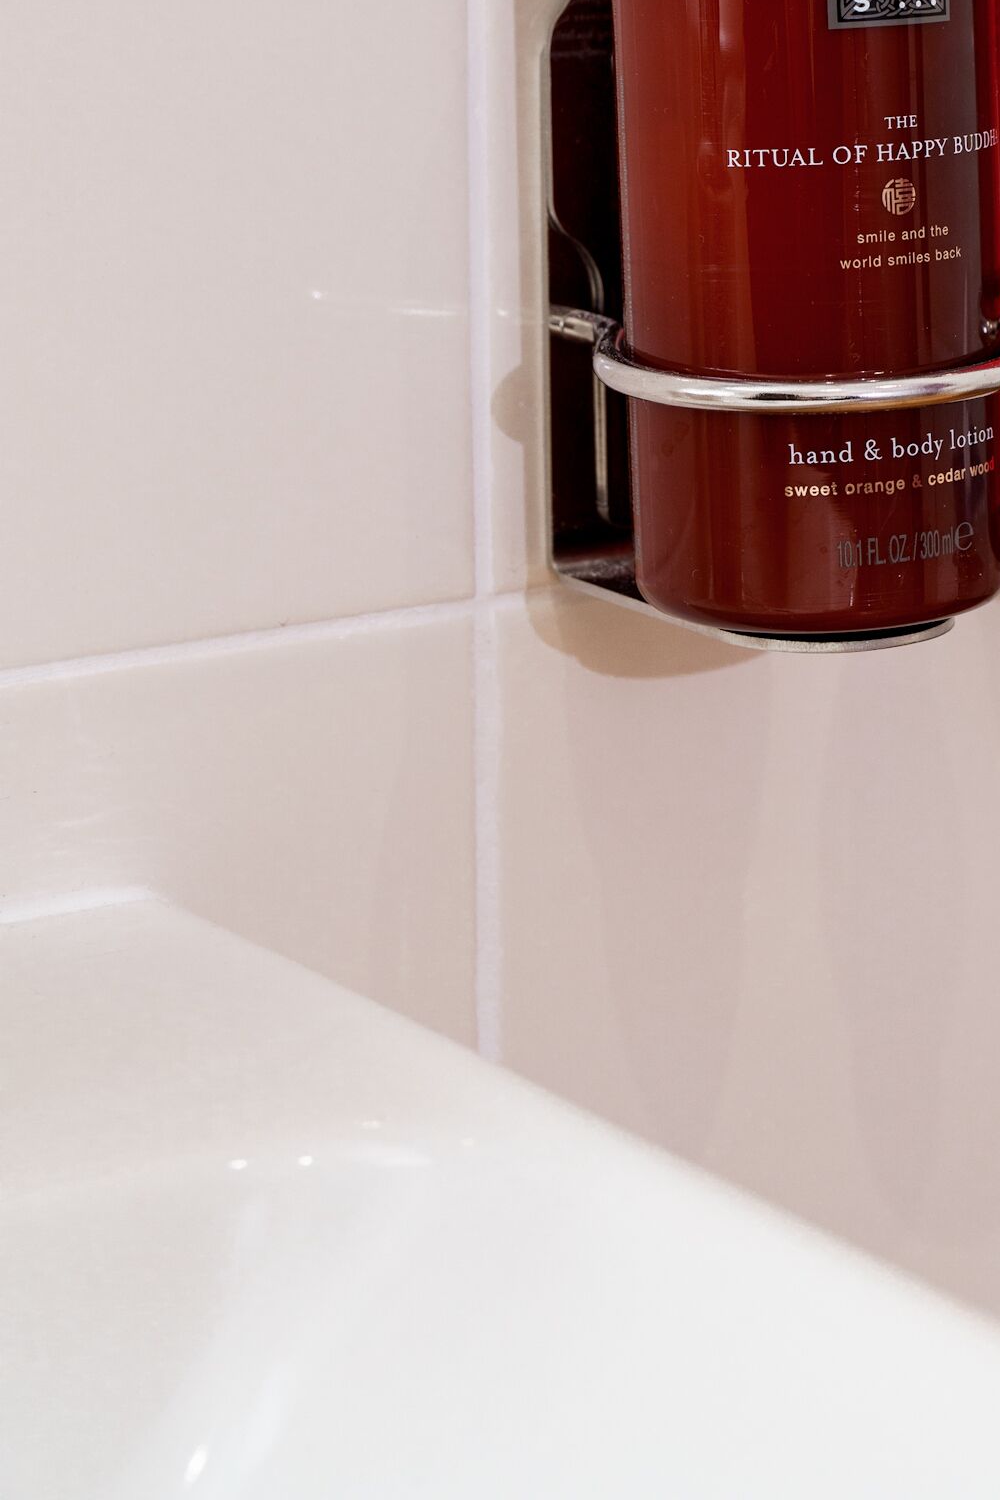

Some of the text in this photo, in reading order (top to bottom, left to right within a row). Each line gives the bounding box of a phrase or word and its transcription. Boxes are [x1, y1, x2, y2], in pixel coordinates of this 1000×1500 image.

[884, 115, 918, 130] THE
[727, 147, 824, 168] RITUAL
[832, 145, 868, 164] OF
[876, 137, 949, 162] HAPPY
[857, 224, 949, 244] smile and the
[840, 246, 962, 270] world smiles back
[788, 426, 994, 465] hand & body lotion
[784, 455, 995, 497] sweet orange & cedar wood
[837, 538, 863, 568] 10.1
[867, 536, 887, 565] FL.
[889, 534, 911, 563] OZ.
